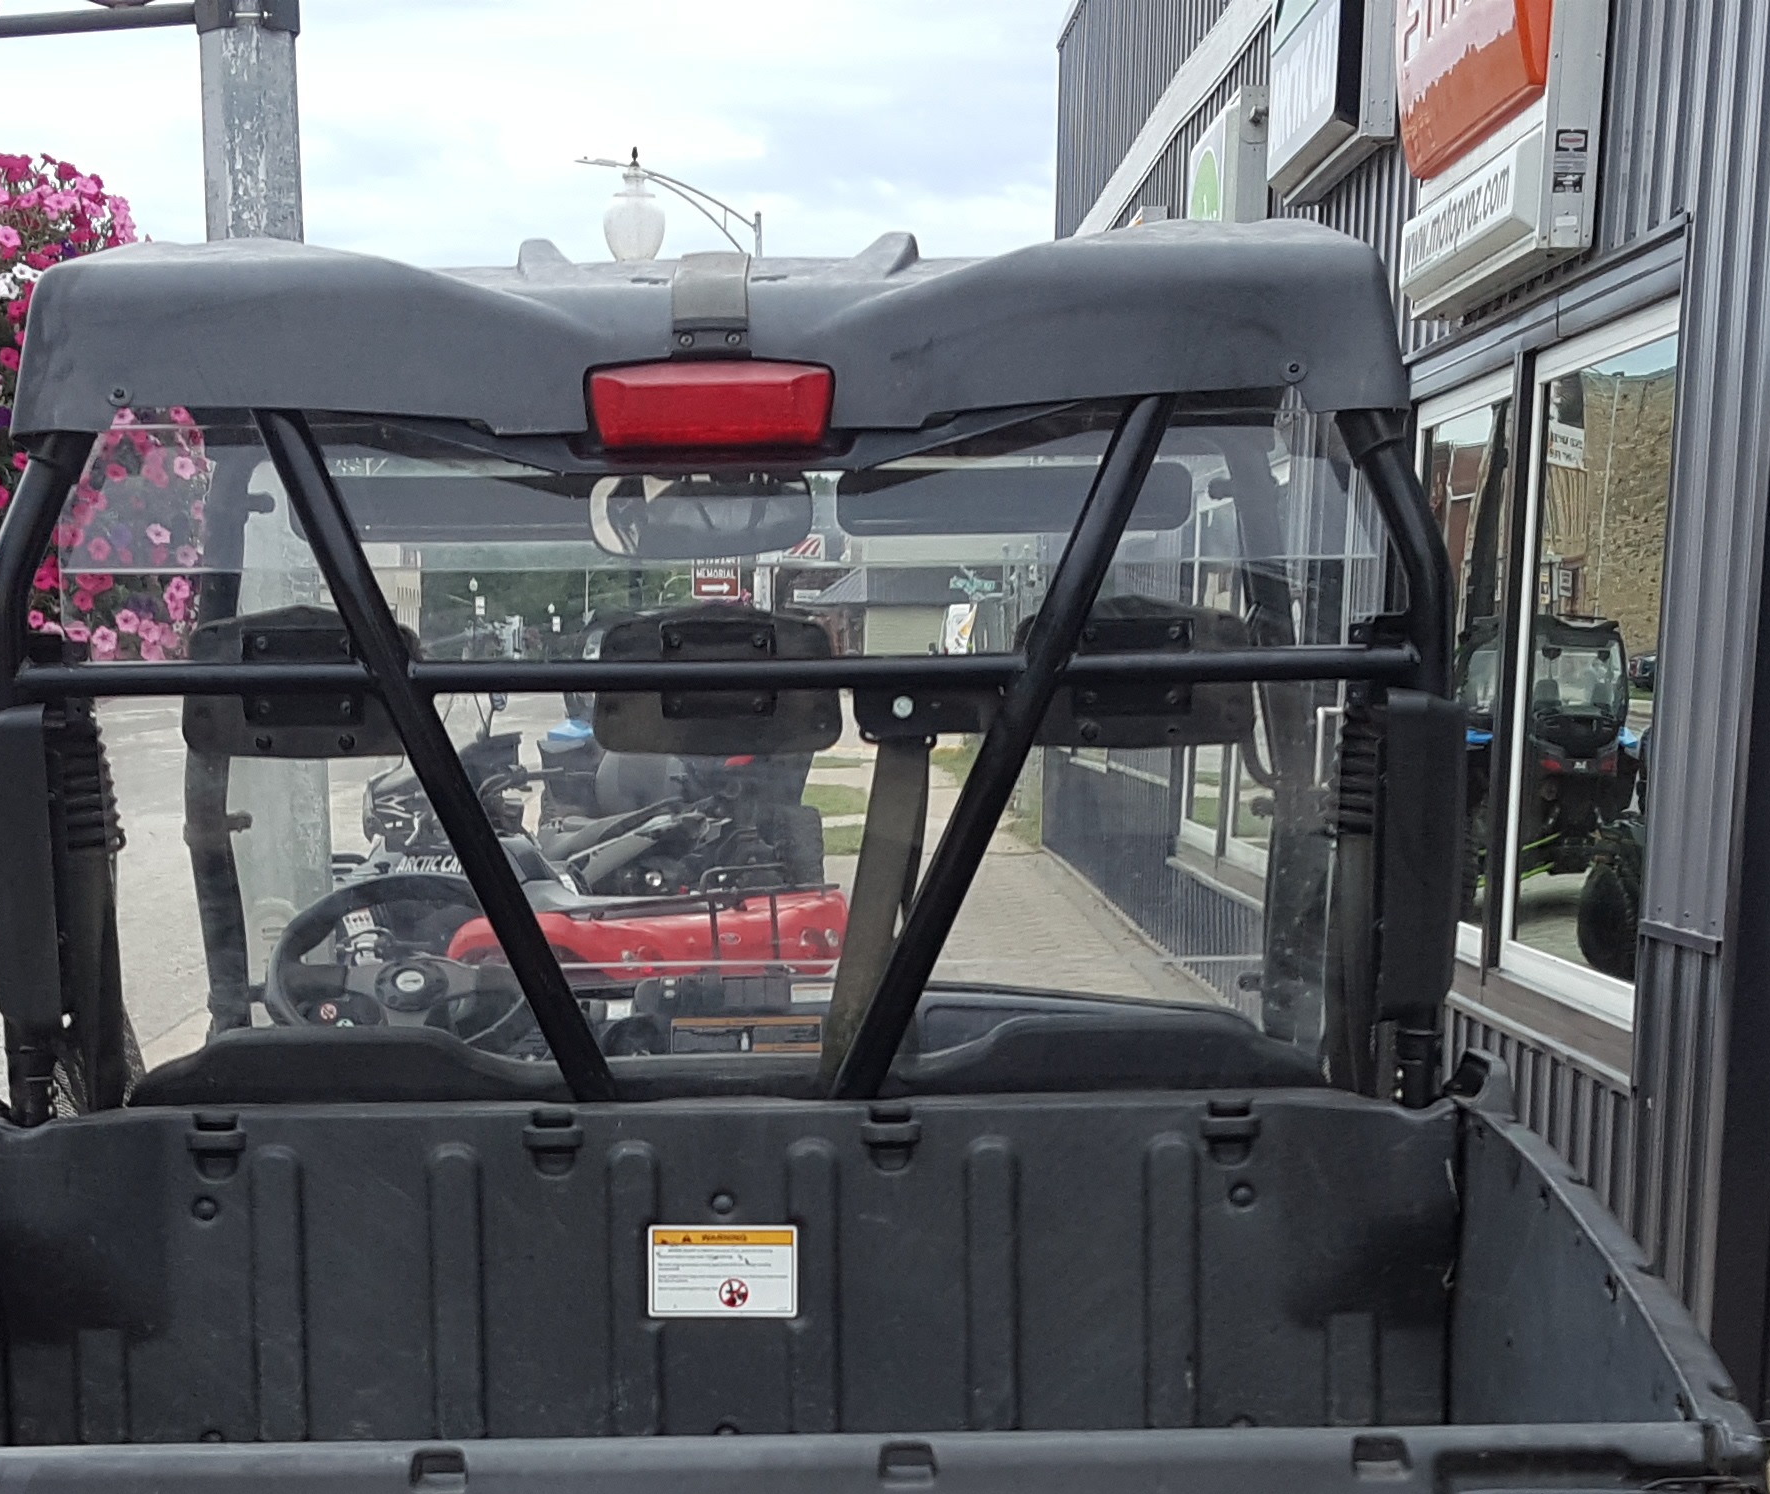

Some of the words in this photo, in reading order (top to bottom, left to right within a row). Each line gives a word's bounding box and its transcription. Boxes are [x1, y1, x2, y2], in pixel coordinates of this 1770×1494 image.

[1404, 164, 1511, 278] www.motoproz.com
[696, 567, 737, 580] MEMORIAL
[396, 855, 442, 873] ARCTIC
